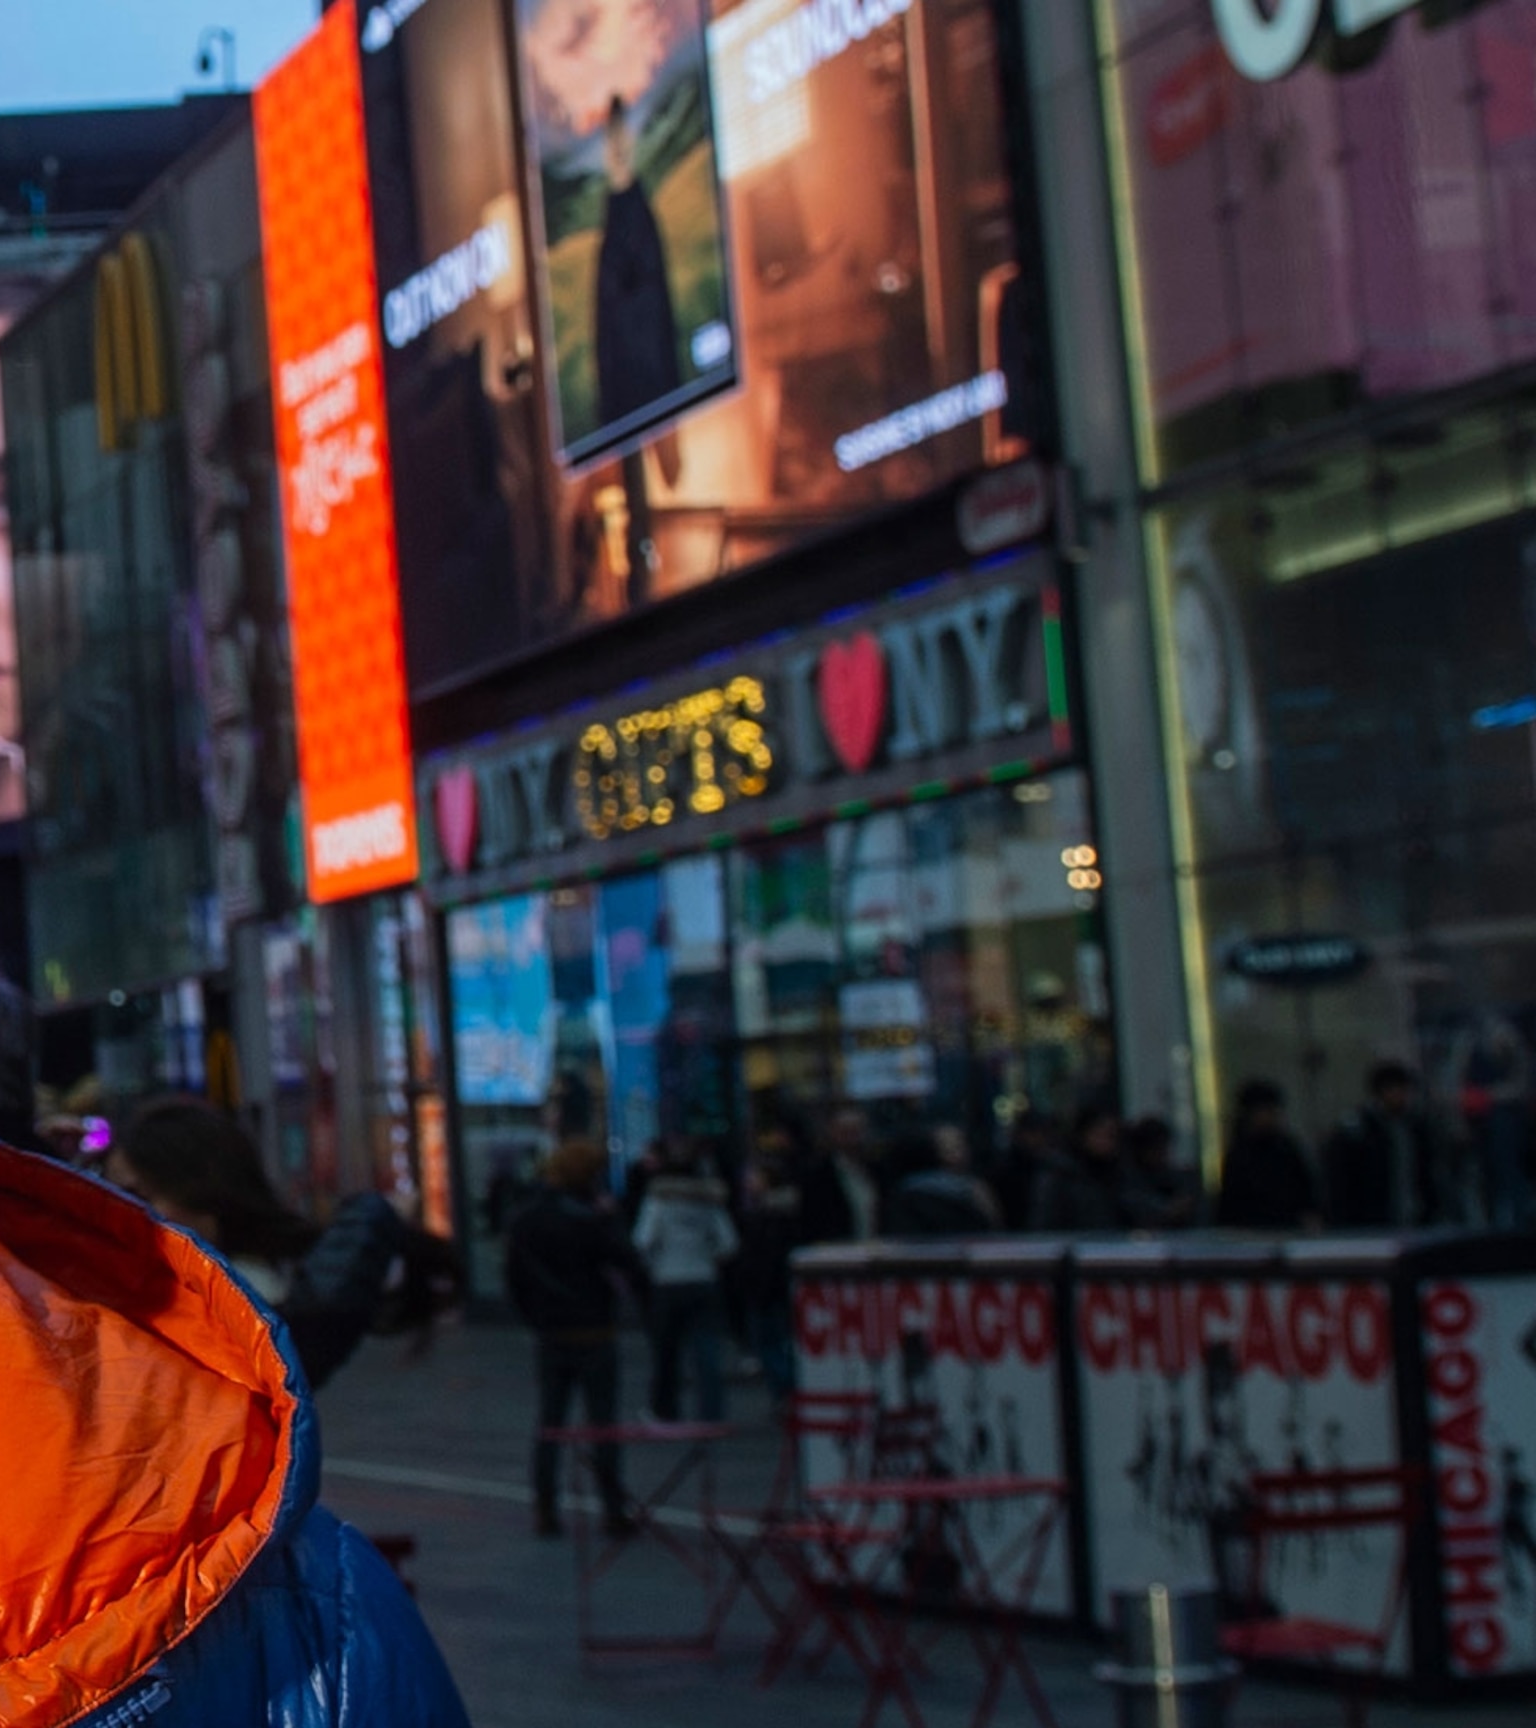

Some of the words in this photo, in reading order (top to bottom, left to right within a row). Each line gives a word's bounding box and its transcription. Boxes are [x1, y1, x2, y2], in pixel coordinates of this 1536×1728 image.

[574, 676, 772, 839] GIFTS
[795, 1281, 1056, 1367] CHICAGO
[1080, 1281, 1390, 1383] CHICAGO
[1425, 1286, 1505, 1671] CHICAGO
